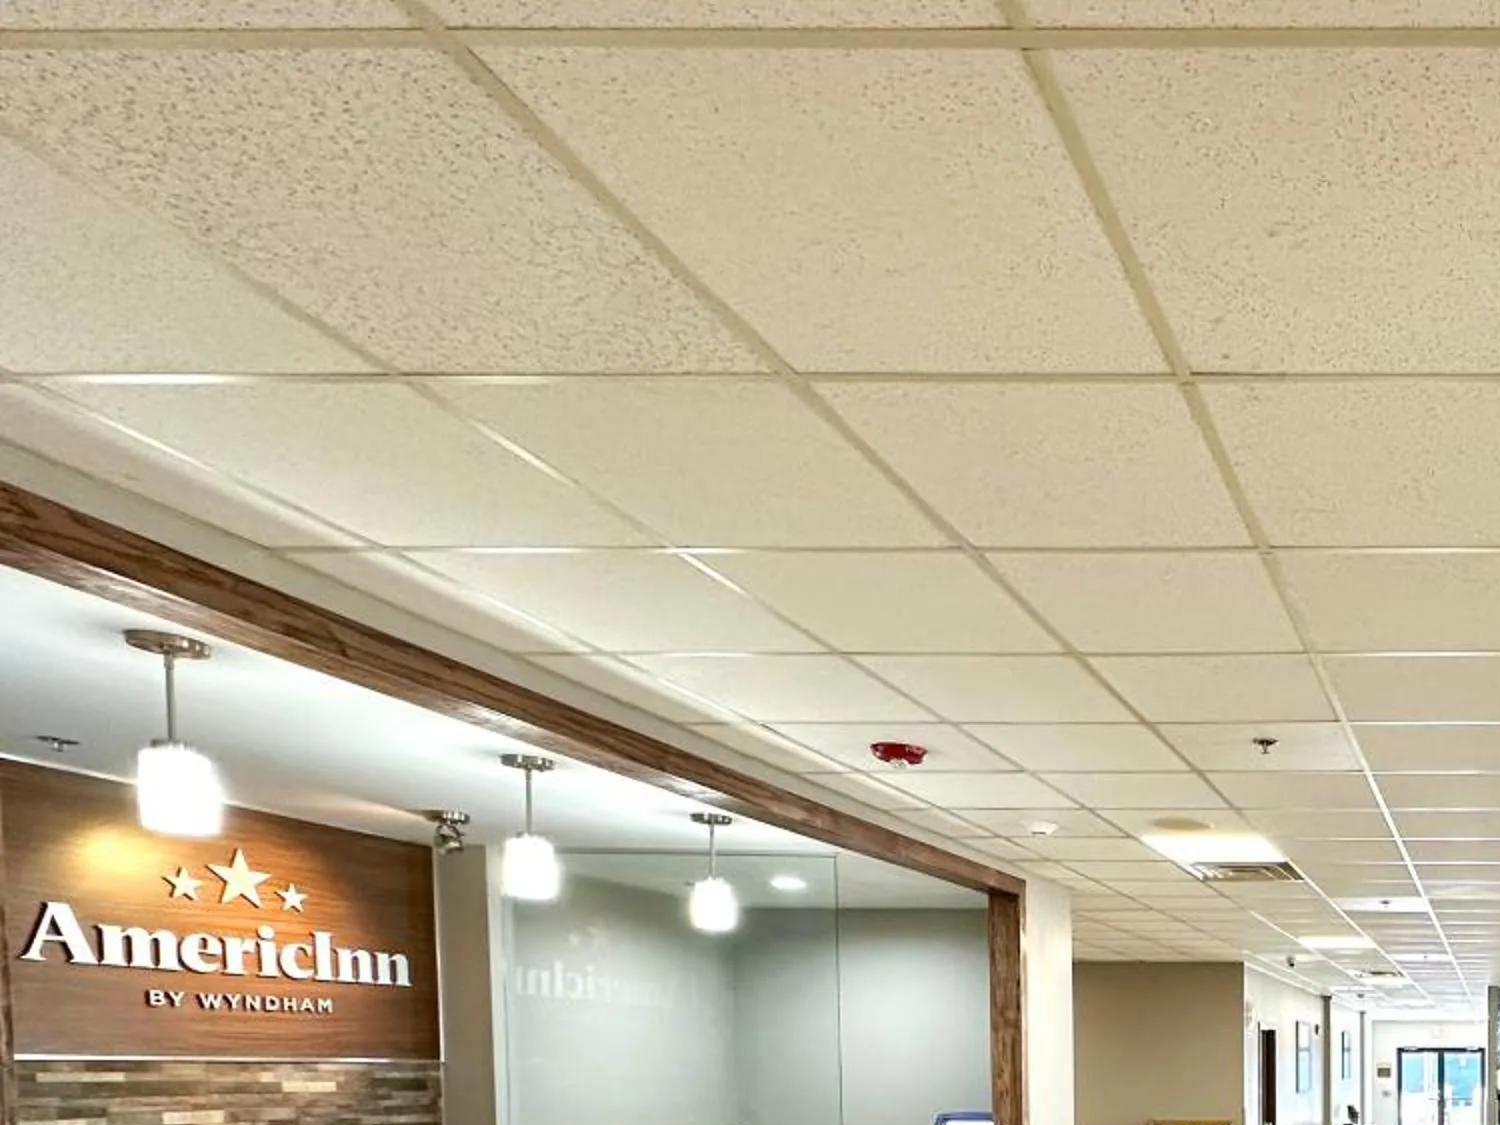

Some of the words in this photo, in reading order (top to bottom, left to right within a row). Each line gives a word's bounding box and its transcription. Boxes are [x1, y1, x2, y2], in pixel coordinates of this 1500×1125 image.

[20, 901, 412, 987] AmericInn
[150, 988, 187, 1008] BY
[201, 993, 334, 1014] WYNDHAM
